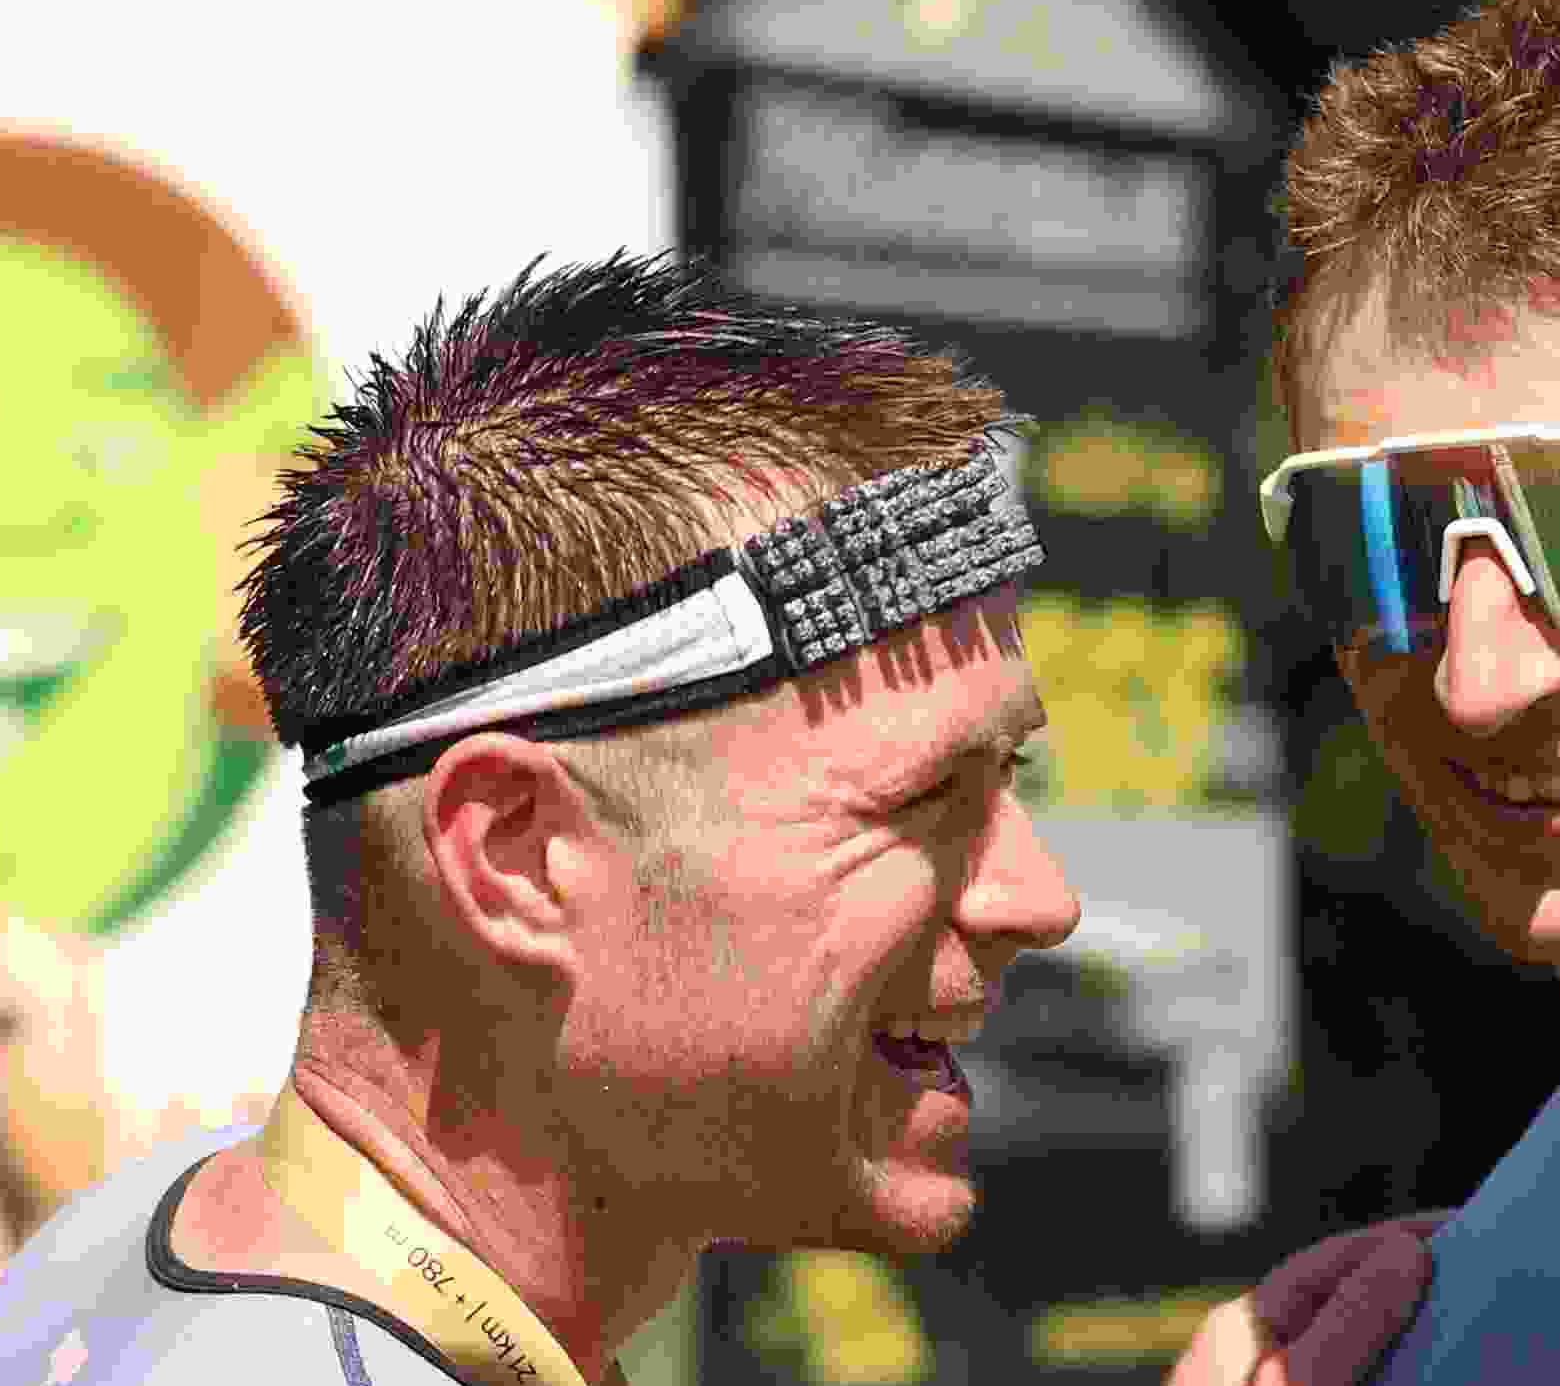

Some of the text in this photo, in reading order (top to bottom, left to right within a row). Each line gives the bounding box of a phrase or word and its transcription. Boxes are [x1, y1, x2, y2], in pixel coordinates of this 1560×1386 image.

[407, 1247, 455, 1294] 780
[480, 1316, 516, 1360] km
[509, 1355, 537, 1386] 21
